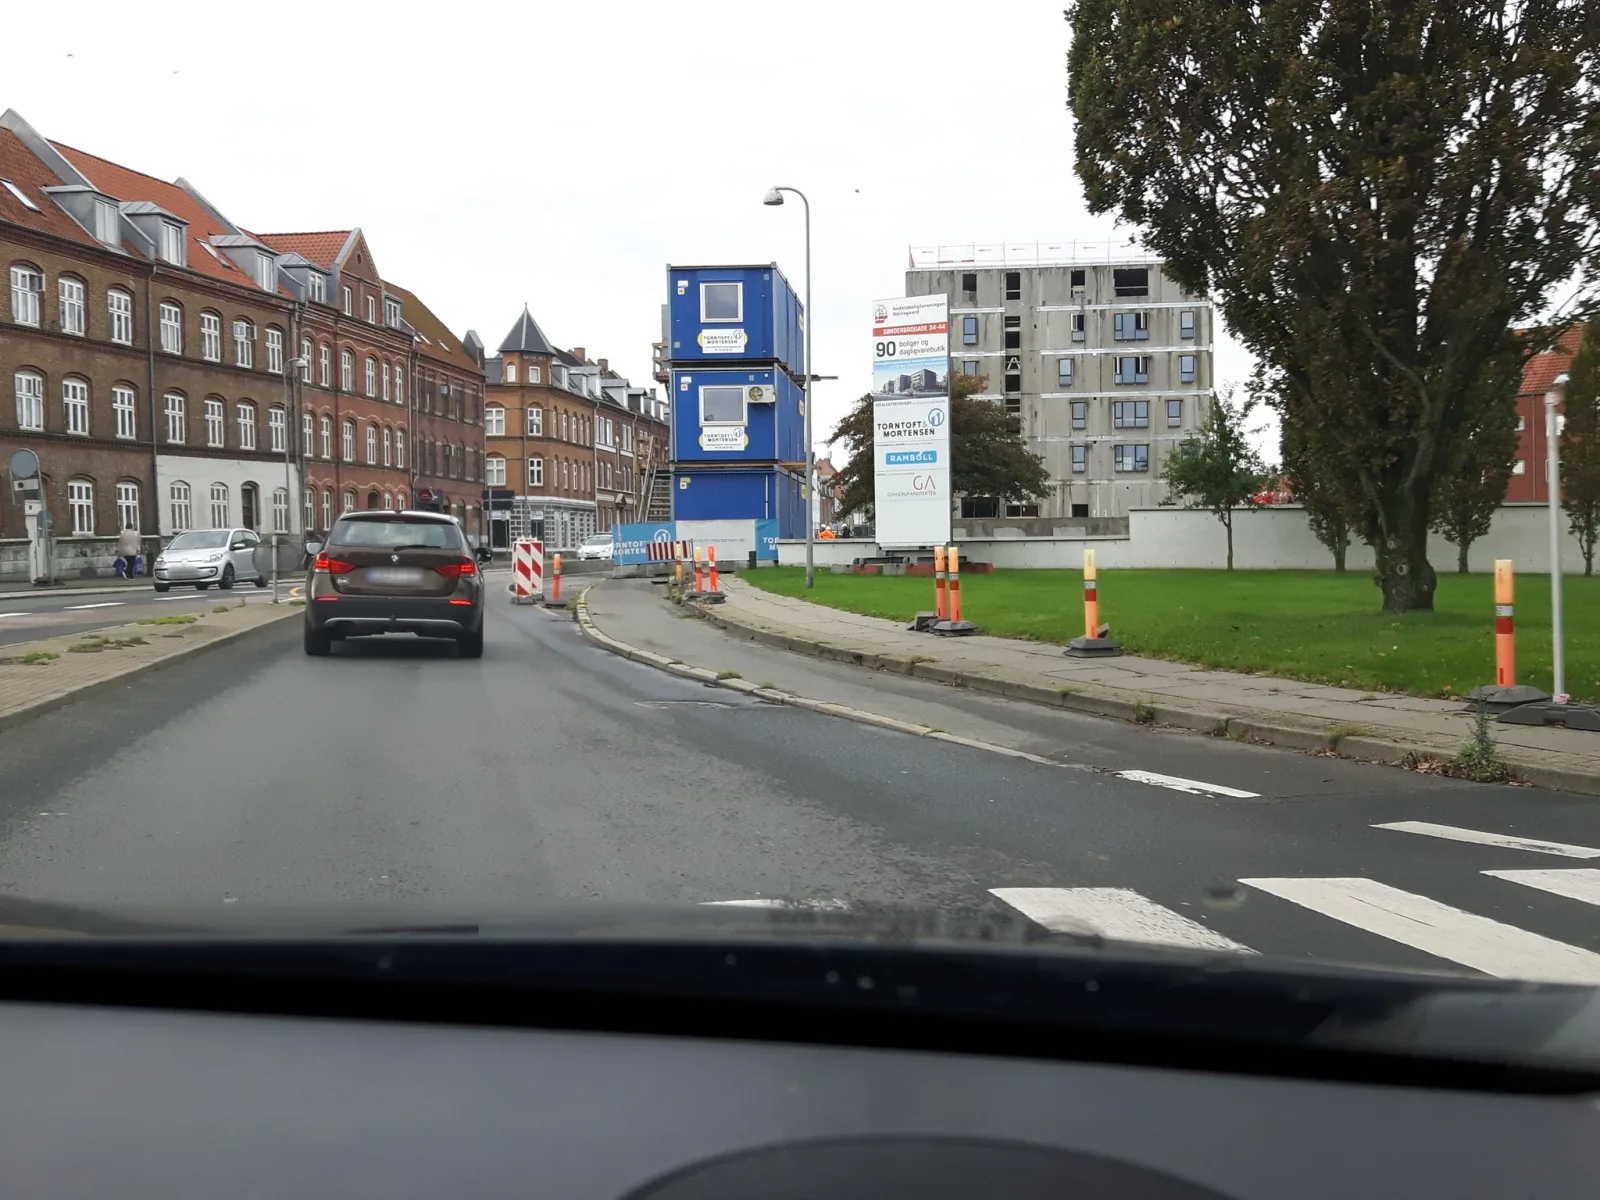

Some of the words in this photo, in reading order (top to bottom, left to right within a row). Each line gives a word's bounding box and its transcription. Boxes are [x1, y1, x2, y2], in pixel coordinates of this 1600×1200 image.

[928, 323, 946, 331] 34-44
[899, 340, 920, 348] boliger
[920, 339, 929, 347] og
[876, 340, 896, 358] 90
[899, 345, 946, 356] dagligvarebutik
[877, 421, 922, 430] TORNTOFT
[922, 420, 928, 428] &
[883, 428, 935, 438] MORTENSEN
[912, 475, 936, 491] GA
